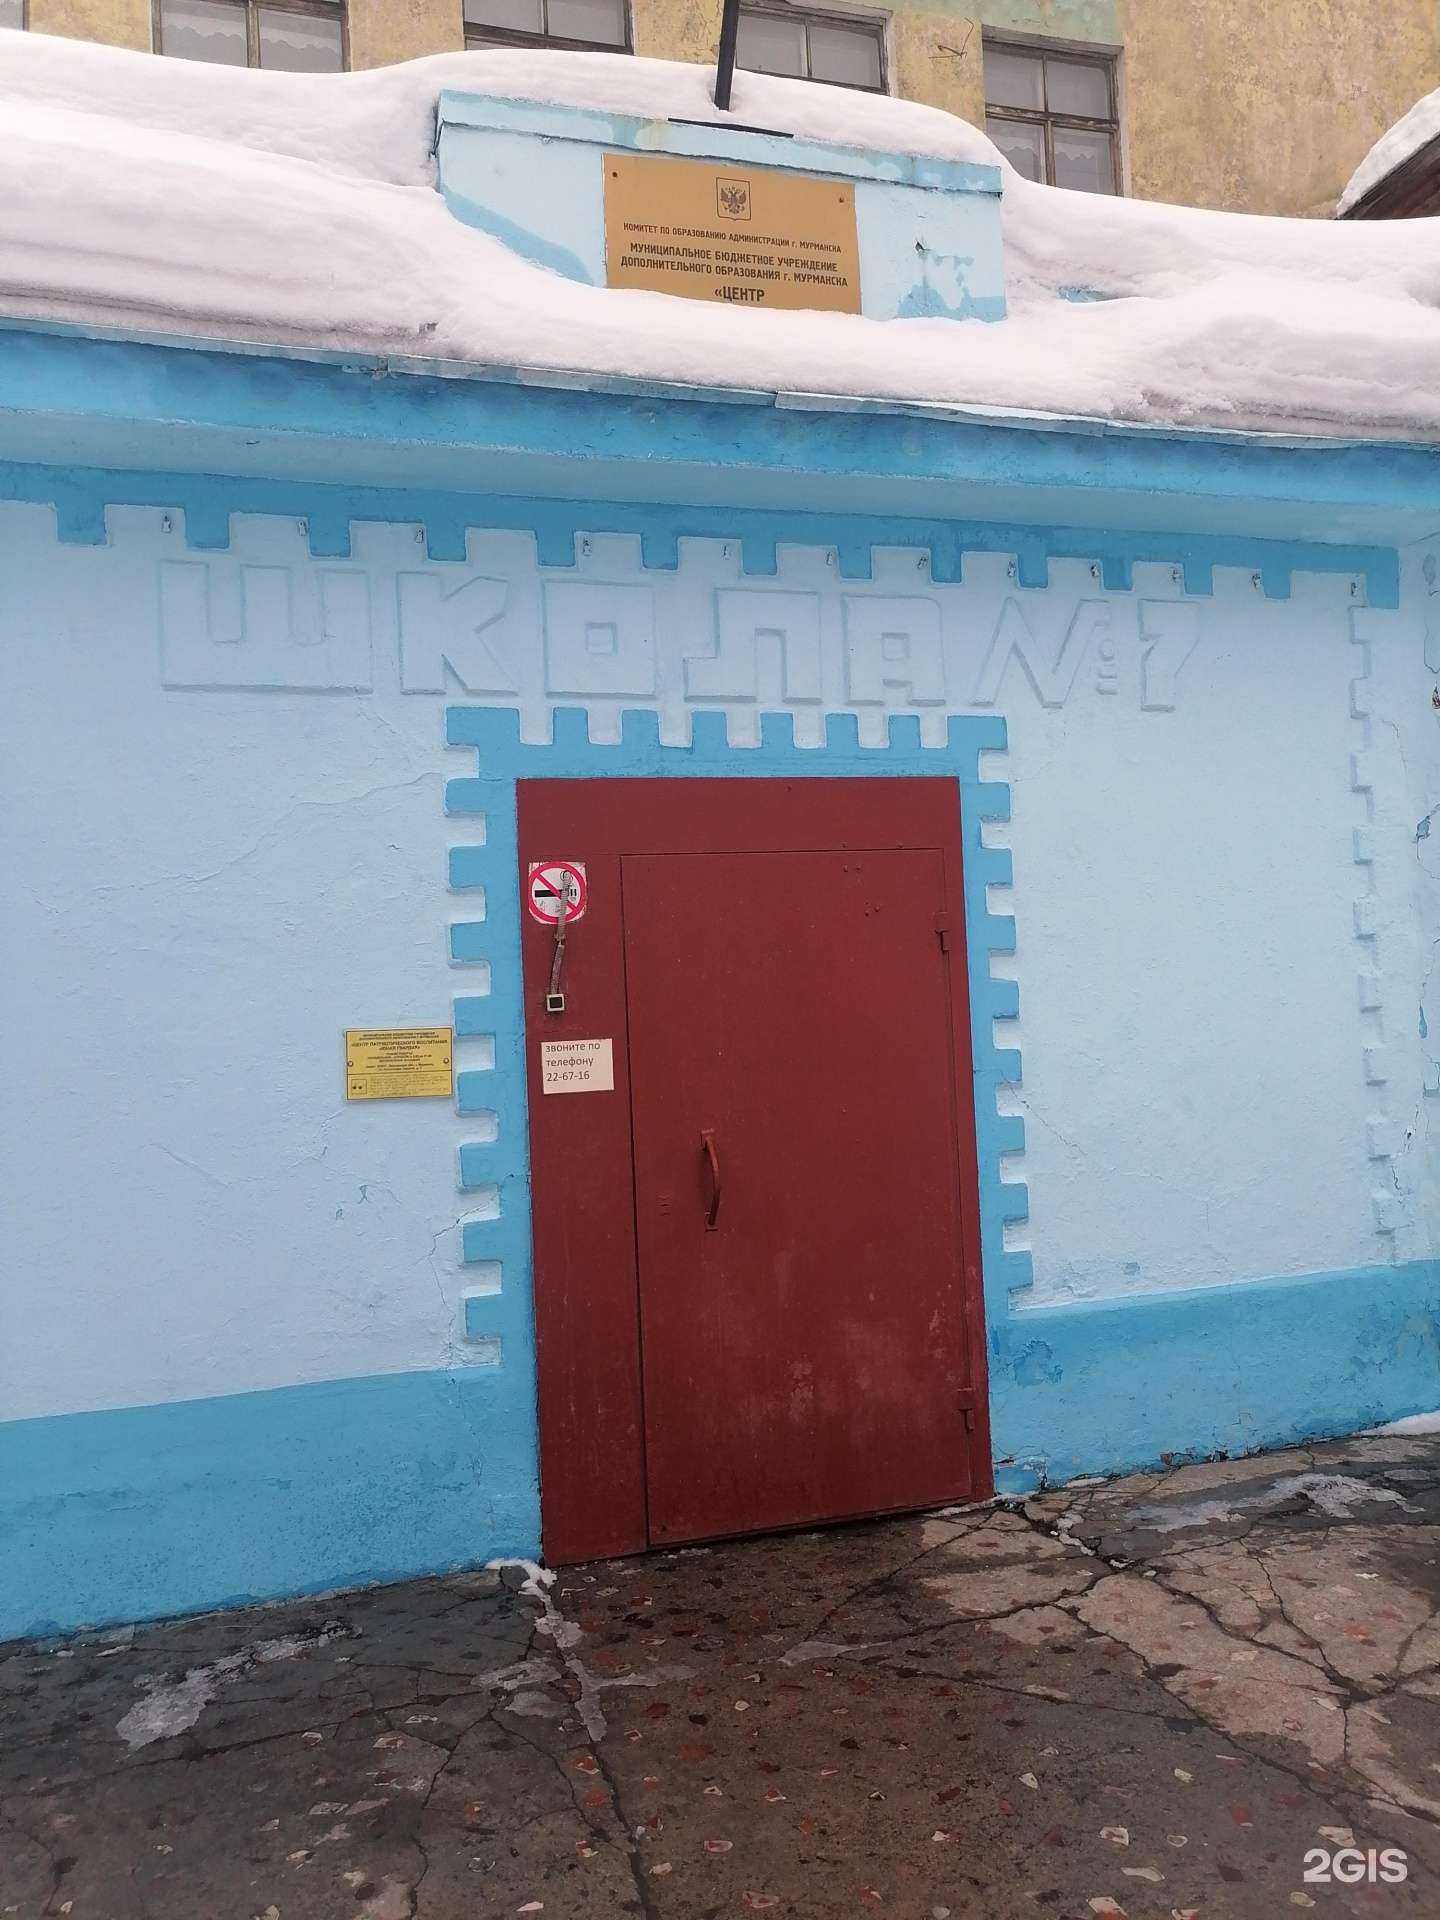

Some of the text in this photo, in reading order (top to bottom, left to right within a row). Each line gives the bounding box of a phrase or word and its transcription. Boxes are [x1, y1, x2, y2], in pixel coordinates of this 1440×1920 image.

[623, 222, 658, 234] КОМИТЕТ
[660, 226, 670, 235] ПО
[672, 227, 726, 240] ОБРАЗОВАНИЮ
[728, 233, 790, 247] АДМИНИСТРАЦИИ
[799, 241, 842, 253] МУРМАНСКА
[630, 242, 838, 272] МУНИЦИПАЛЬНОЕ БЮДЖЕТНОЕ УЧРЕЖДЕНИЕ
[620, 255, 848, 287] ДОПОЛНИТЕЛЬНОГО ОБРАЗОВАНИЯ г. МУРМАНСКА
[714, 285, 765, 302] «ЦЕНТР
[160, 559, 946, 707] ШКОЛА
[545, 1042, 601, 1053] звоните по
[546, 1056, 594, 1068] телефону
[546, 1070, 590, 1082] 22-67-16
